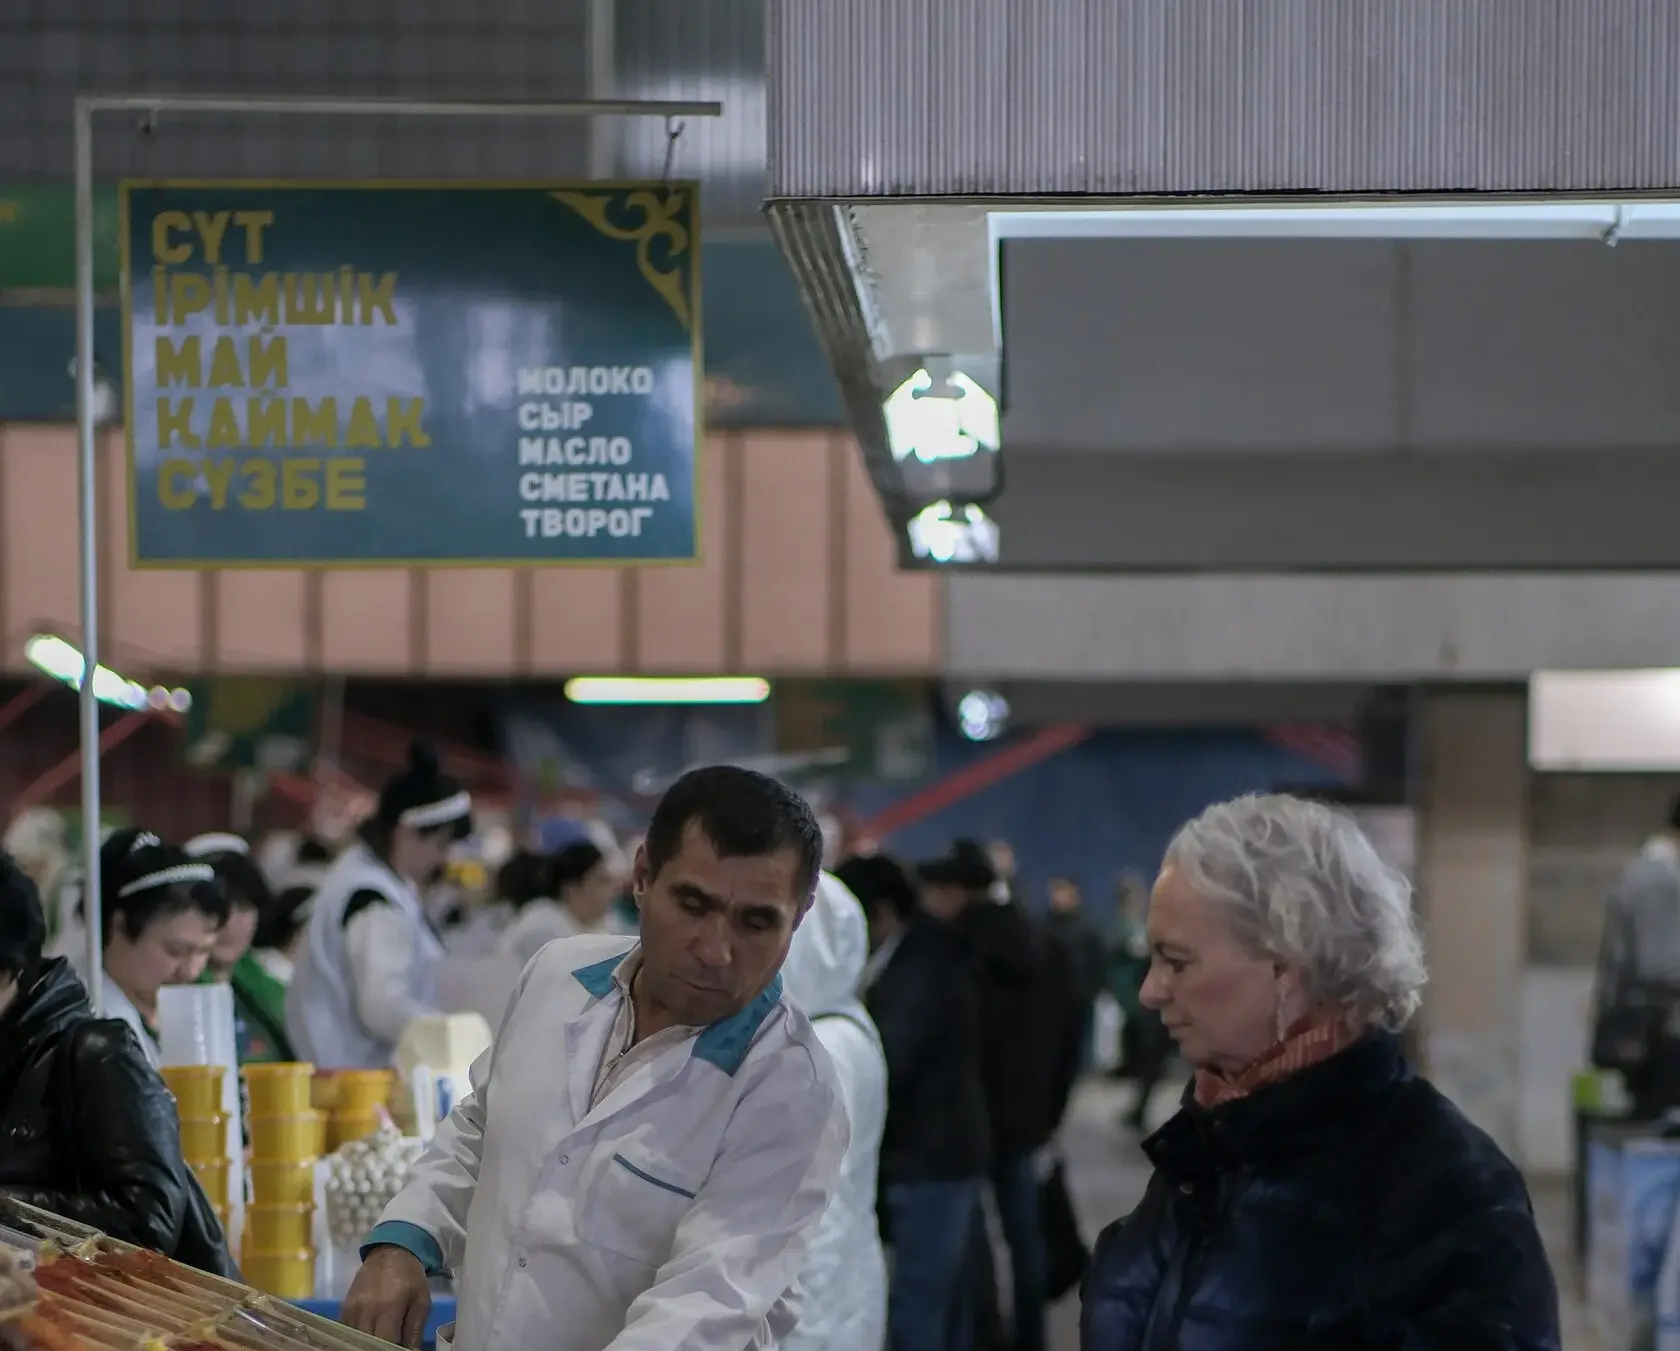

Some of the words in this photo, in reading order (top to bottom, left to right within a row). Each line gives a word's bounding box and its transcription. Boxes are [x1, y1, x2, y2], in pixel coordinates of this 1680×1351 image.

[155, 325, 288, 388] МАЙ
[518, 366, 654, 395] МОЛОКО
[518, 402, 593, 430] СЫР
[518, 436, 632, 466] МАСЛО
[519, 472, 670, 501] СМЕТАНА
[520, 507, 654, 537] ТВОРОГ
